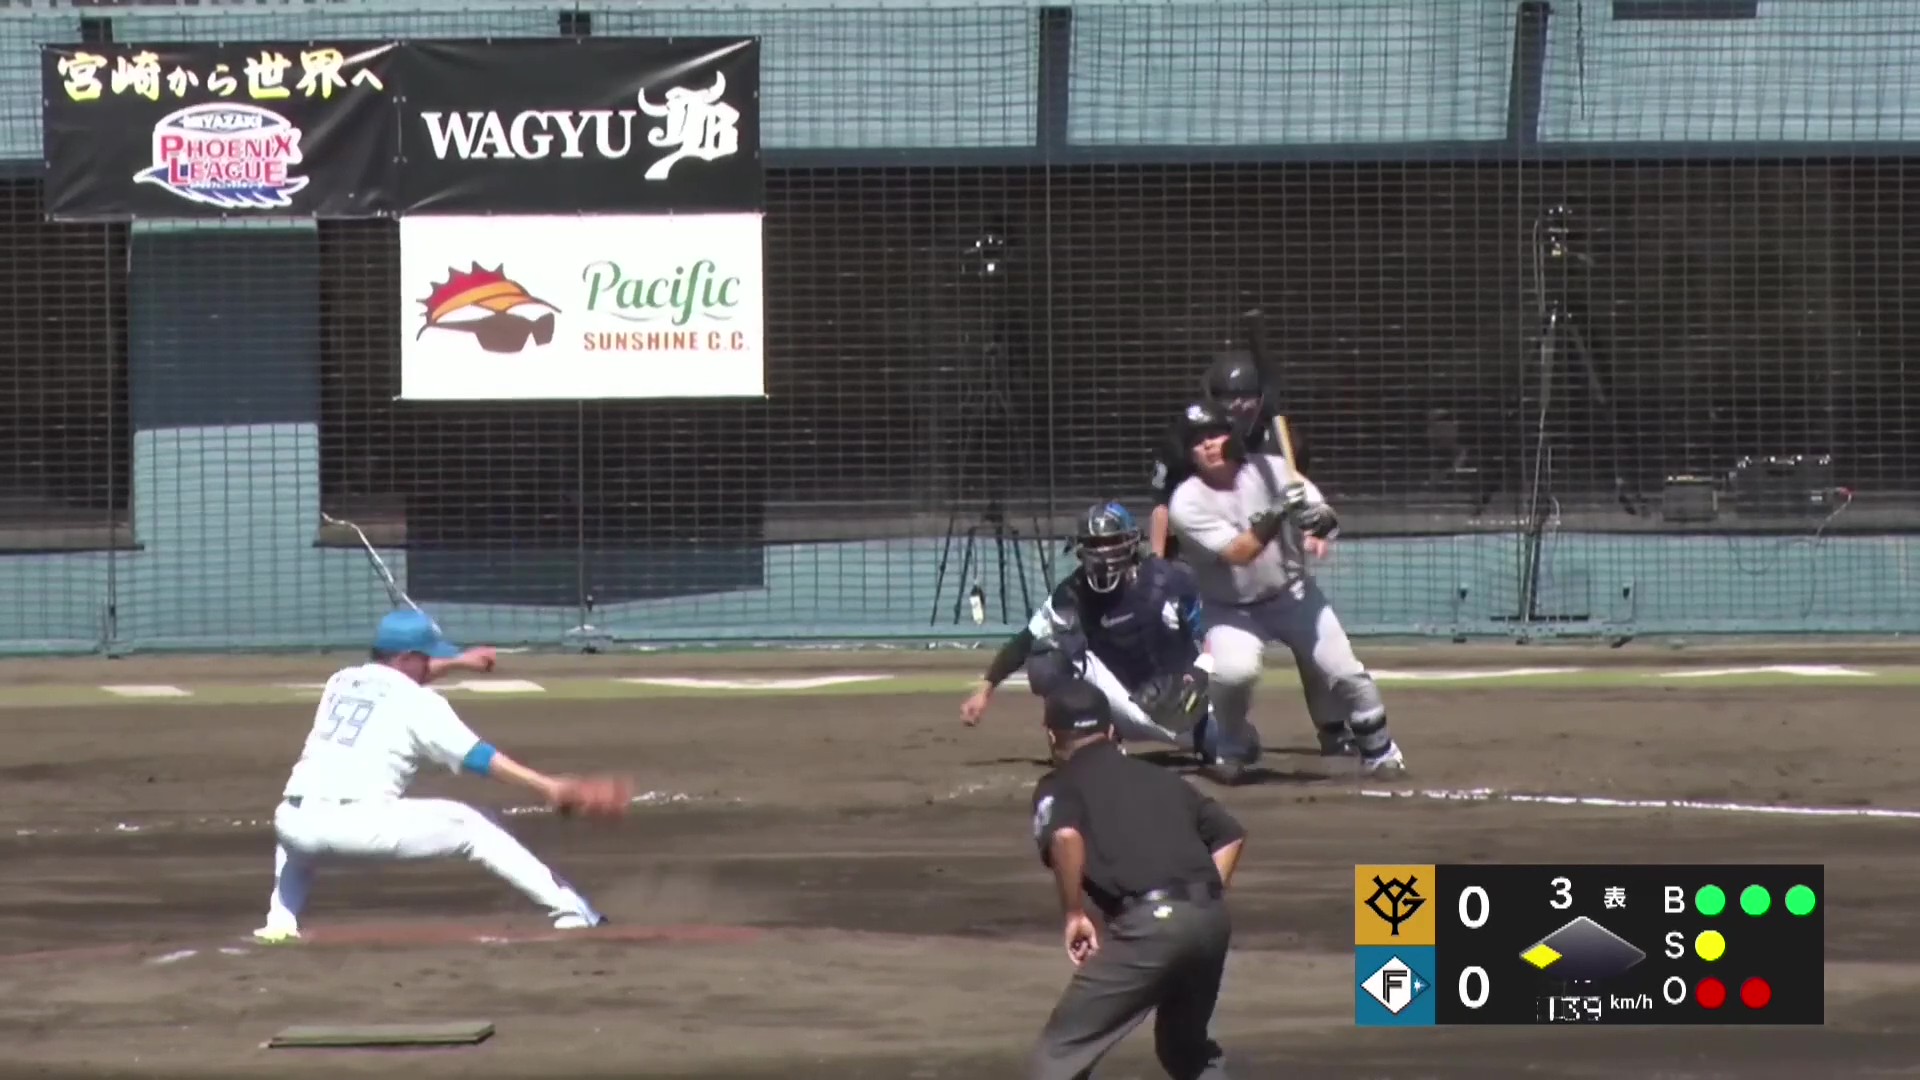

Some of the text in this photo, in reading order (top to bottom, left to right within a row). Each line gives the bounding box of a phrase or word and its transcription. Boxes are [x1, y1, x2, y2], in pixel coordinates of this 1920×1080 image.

[58, 49, 383, 101] 宮崎から世界へ
[183, 110, 262, 129] YAZAKI
[420, 109, 637, 159] WAGYU
[161, 134, 292, 161] PHOENIX
[170, 157, 284, 184] LEAGUE
[582, 258, 741, 326] Pacific
[583, 331, 750, 351] SUNSHINE C.C.
[320, 697, 375, 748] 59
